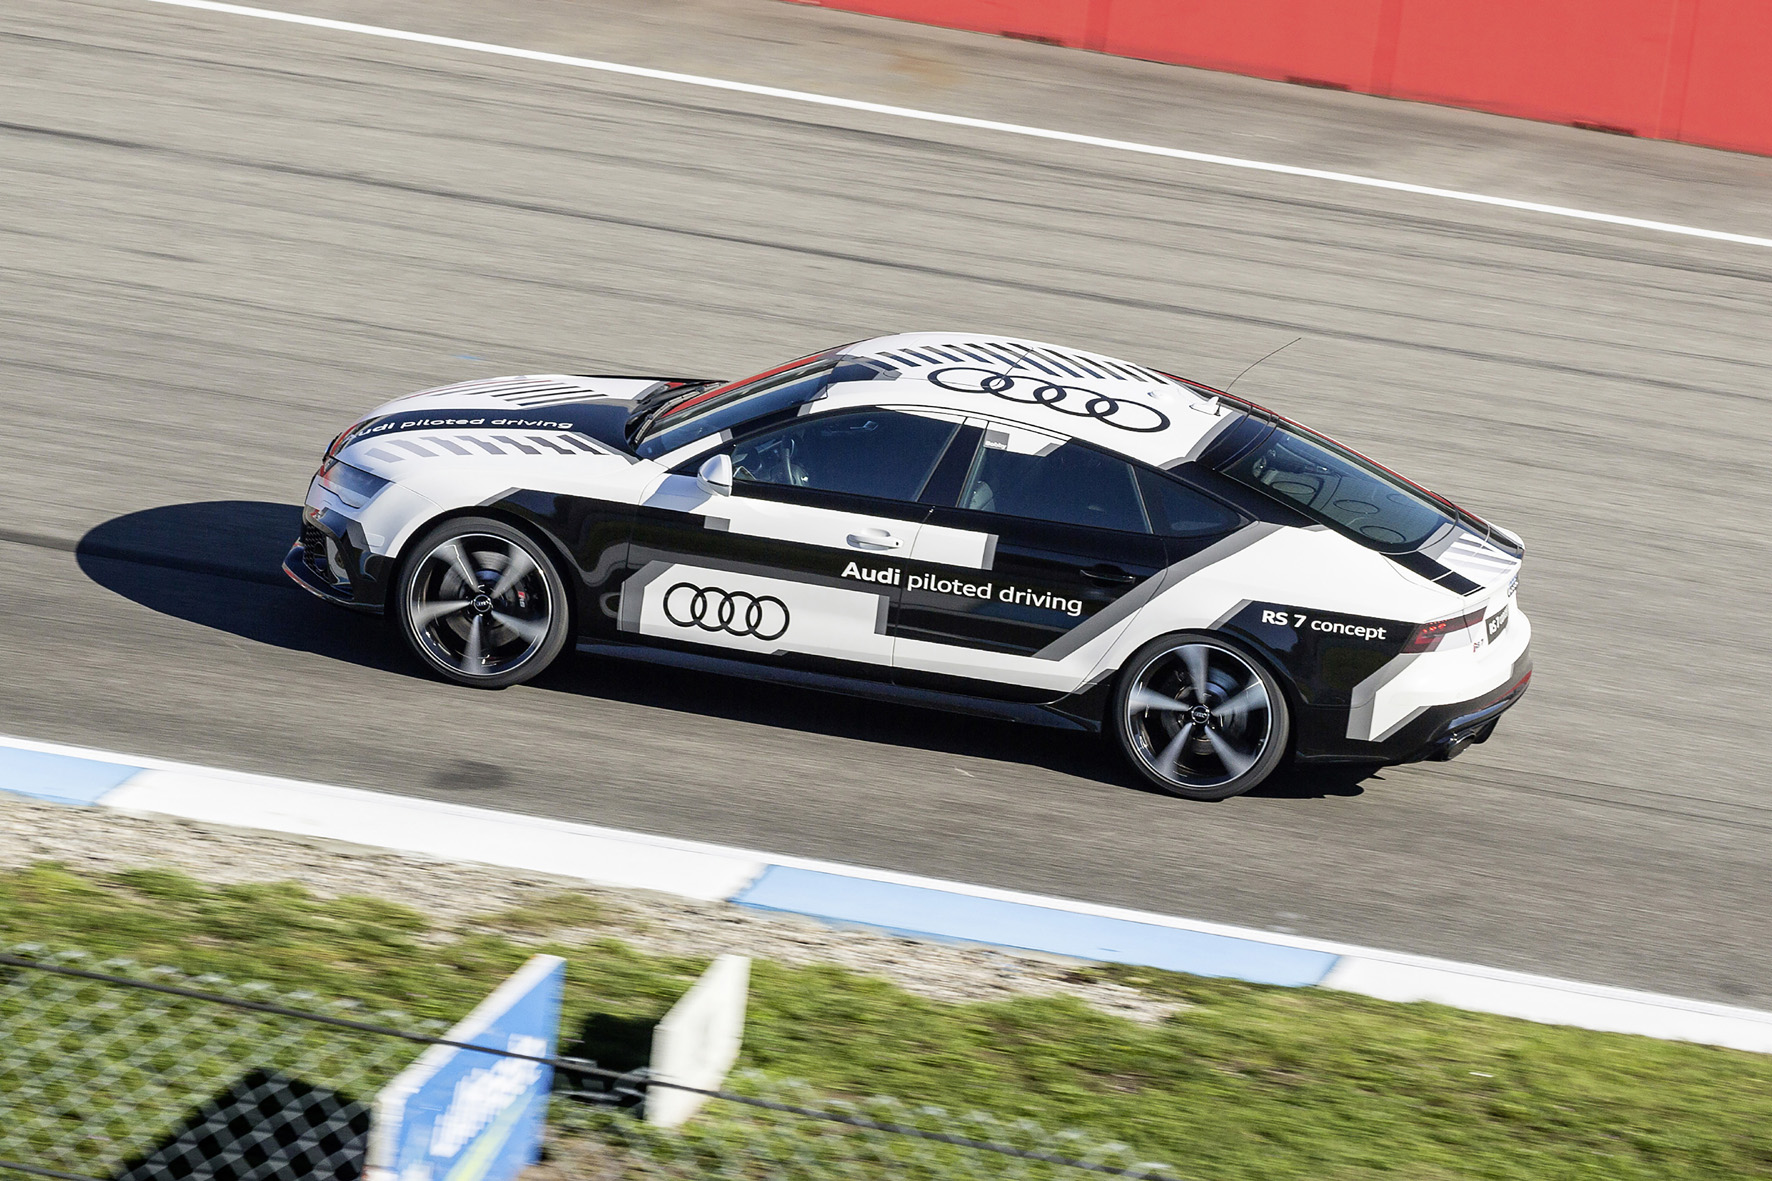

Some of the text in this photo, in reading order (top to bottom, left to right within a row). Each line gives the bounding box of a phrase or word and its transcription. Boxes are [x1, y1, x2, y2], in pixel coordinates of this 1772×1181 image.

[400, 418, 485, 429] piloted
[491, 418, 573, 429] driving
[985, 440, 1008, 450] Bobby
[841, 561, 1083, 617] Audi piloted driving
[1262, 610, 1387, 641] RS 7 concept
